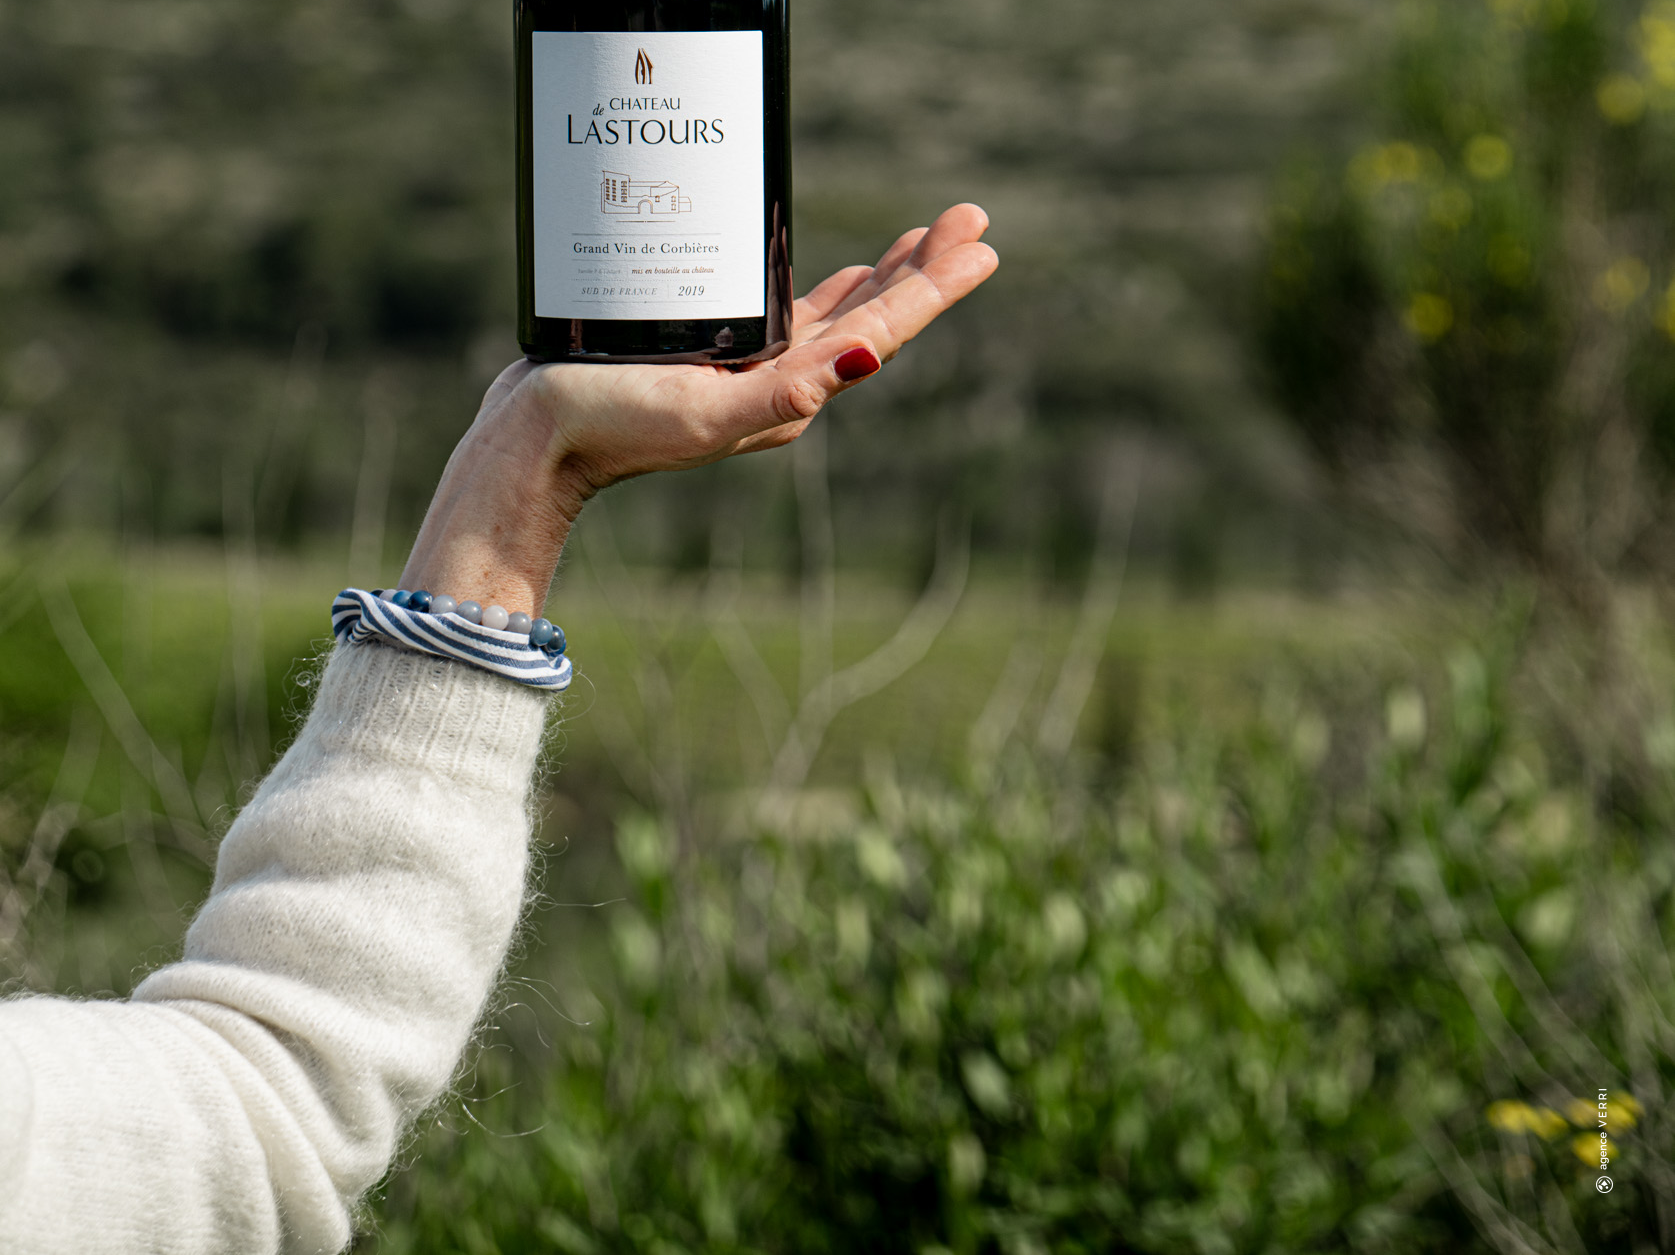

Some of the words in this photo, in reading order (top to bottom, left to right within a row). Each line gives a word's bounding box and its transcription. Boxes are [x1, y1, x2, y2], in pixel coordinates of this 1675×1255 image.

[592, 104, 604, 115] de
[609, 97, 680, 111] CHATEAU
[568, 114, 724, 145] LASTOURS
[574, 242, 609, 253] Grand
[615, 243, 636, 253] Vin
[642, 244, 655, 253] de
[661, 243, 719, 253] Corbières
[678, 286, 705, 296] 2019
